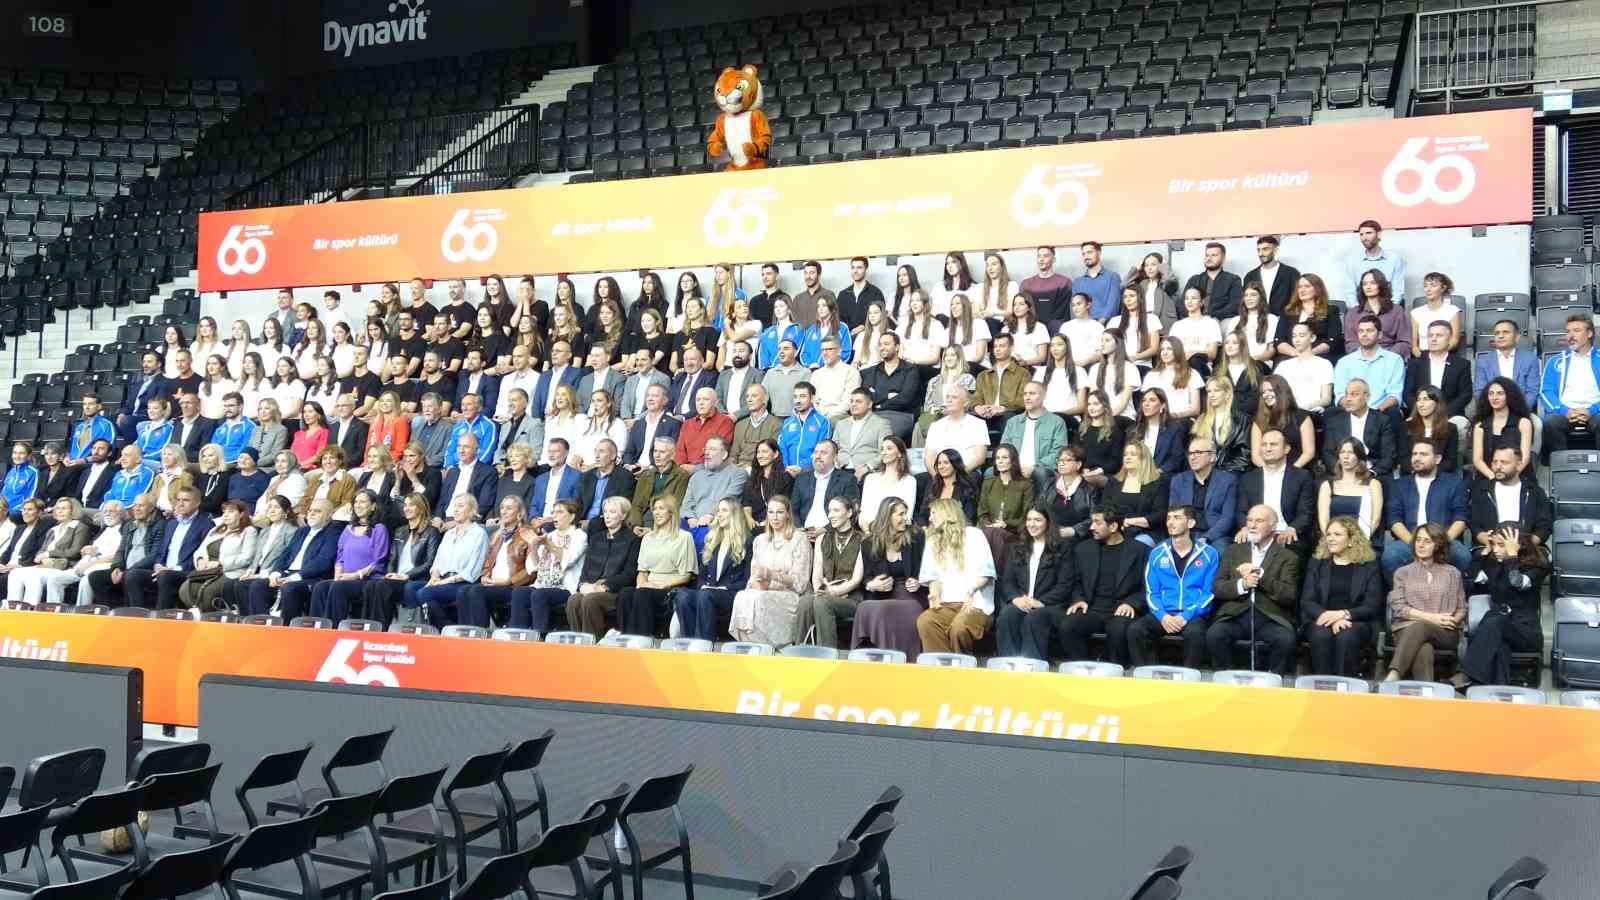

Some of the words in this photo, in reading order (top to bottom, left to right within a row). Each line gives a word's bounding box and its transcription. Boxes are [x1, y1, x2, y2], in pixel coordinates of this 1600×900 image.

[28, 16, 65, 33] 108
[323, 10, 427, 57] Dynavit
[1011, 163, 1090, 228] 60
[1168, 178, 1197, 194] Bir
[1199, 176, 1239, 193] spor
[1242, 170, 1310, 190] kültürü
[1381, 136, 1477, 207] 60
[441, 208, 497, 263] 60
[703, 187, 769, 247] 60
[217, 225, 266, 275] 60
[313, 238, 331, 250] Bir
[331, 237, 357, 251] spor
[735, 688, 801, 717] Bir
